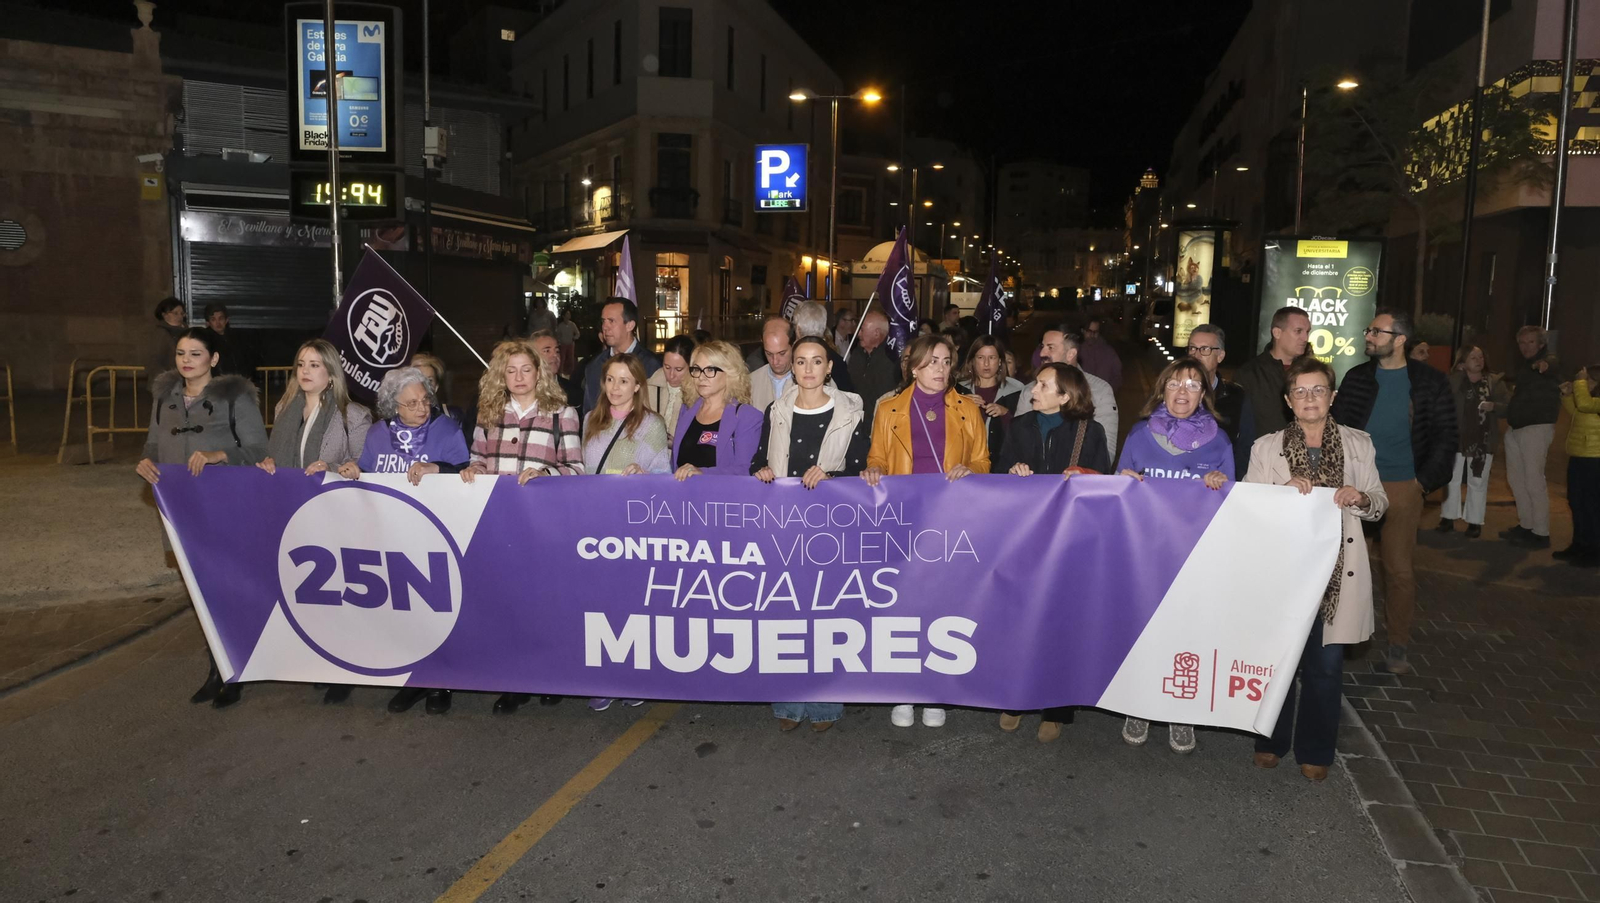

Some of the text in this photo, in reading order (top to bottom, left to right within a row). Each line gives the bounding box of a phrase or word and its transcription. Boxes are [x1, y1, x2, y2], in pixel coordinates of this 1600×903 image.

[307, 41, 320, 51] de
[308, 52, 347, 62] Galia
[761, 150, 790, 188] P
[218, 219, 232, 234] El
[236, 220, 283, 236] Sevillano
[1286, 298, 1348, 312] BLACK
[626, 494, 912, 529] DÍA INTERNACIONAL
[576, 529, 980, 566] CONTRA LA VIOLENCIA
[288, 545, 453, 613] 25N
[644, 567, 900, 611] HACIA LAS
[584, 611, 978, 675] MUJERES
[1230, 659, 1276, 678] Almerí
